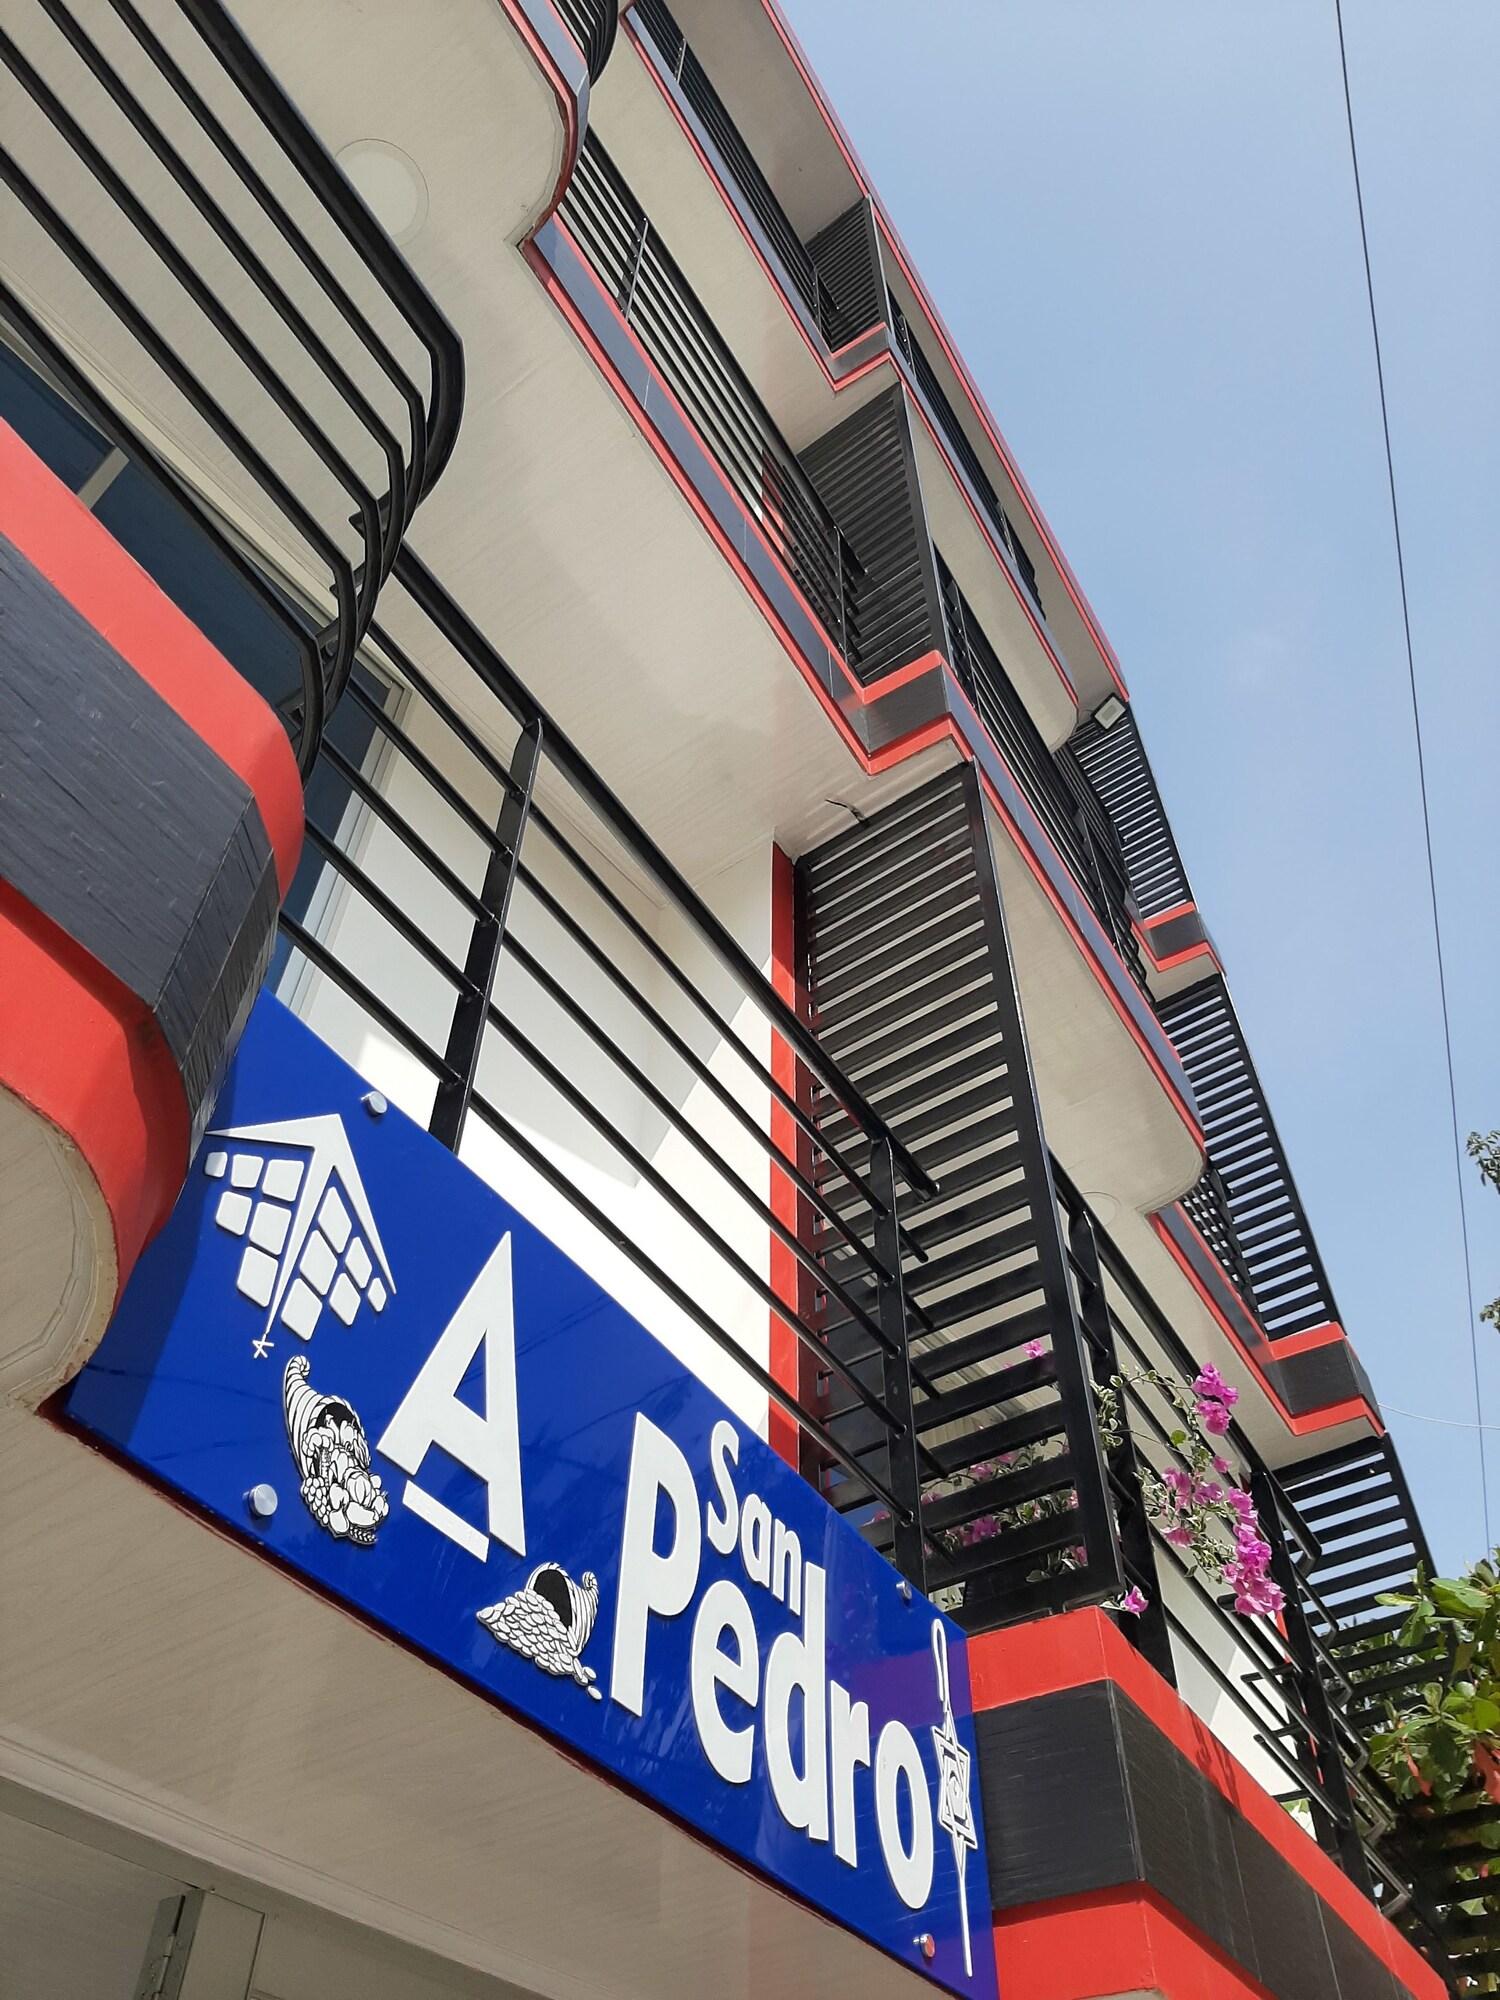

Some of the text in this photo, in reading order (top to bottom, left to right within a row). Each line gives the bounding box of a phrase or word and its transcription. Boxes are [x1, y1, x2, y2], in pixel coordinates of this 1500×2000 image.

[376, 1230, 527, 1558] A
[706, 1419, 802, 1616] San
[610, 1411, 935, 1909] Pedro
